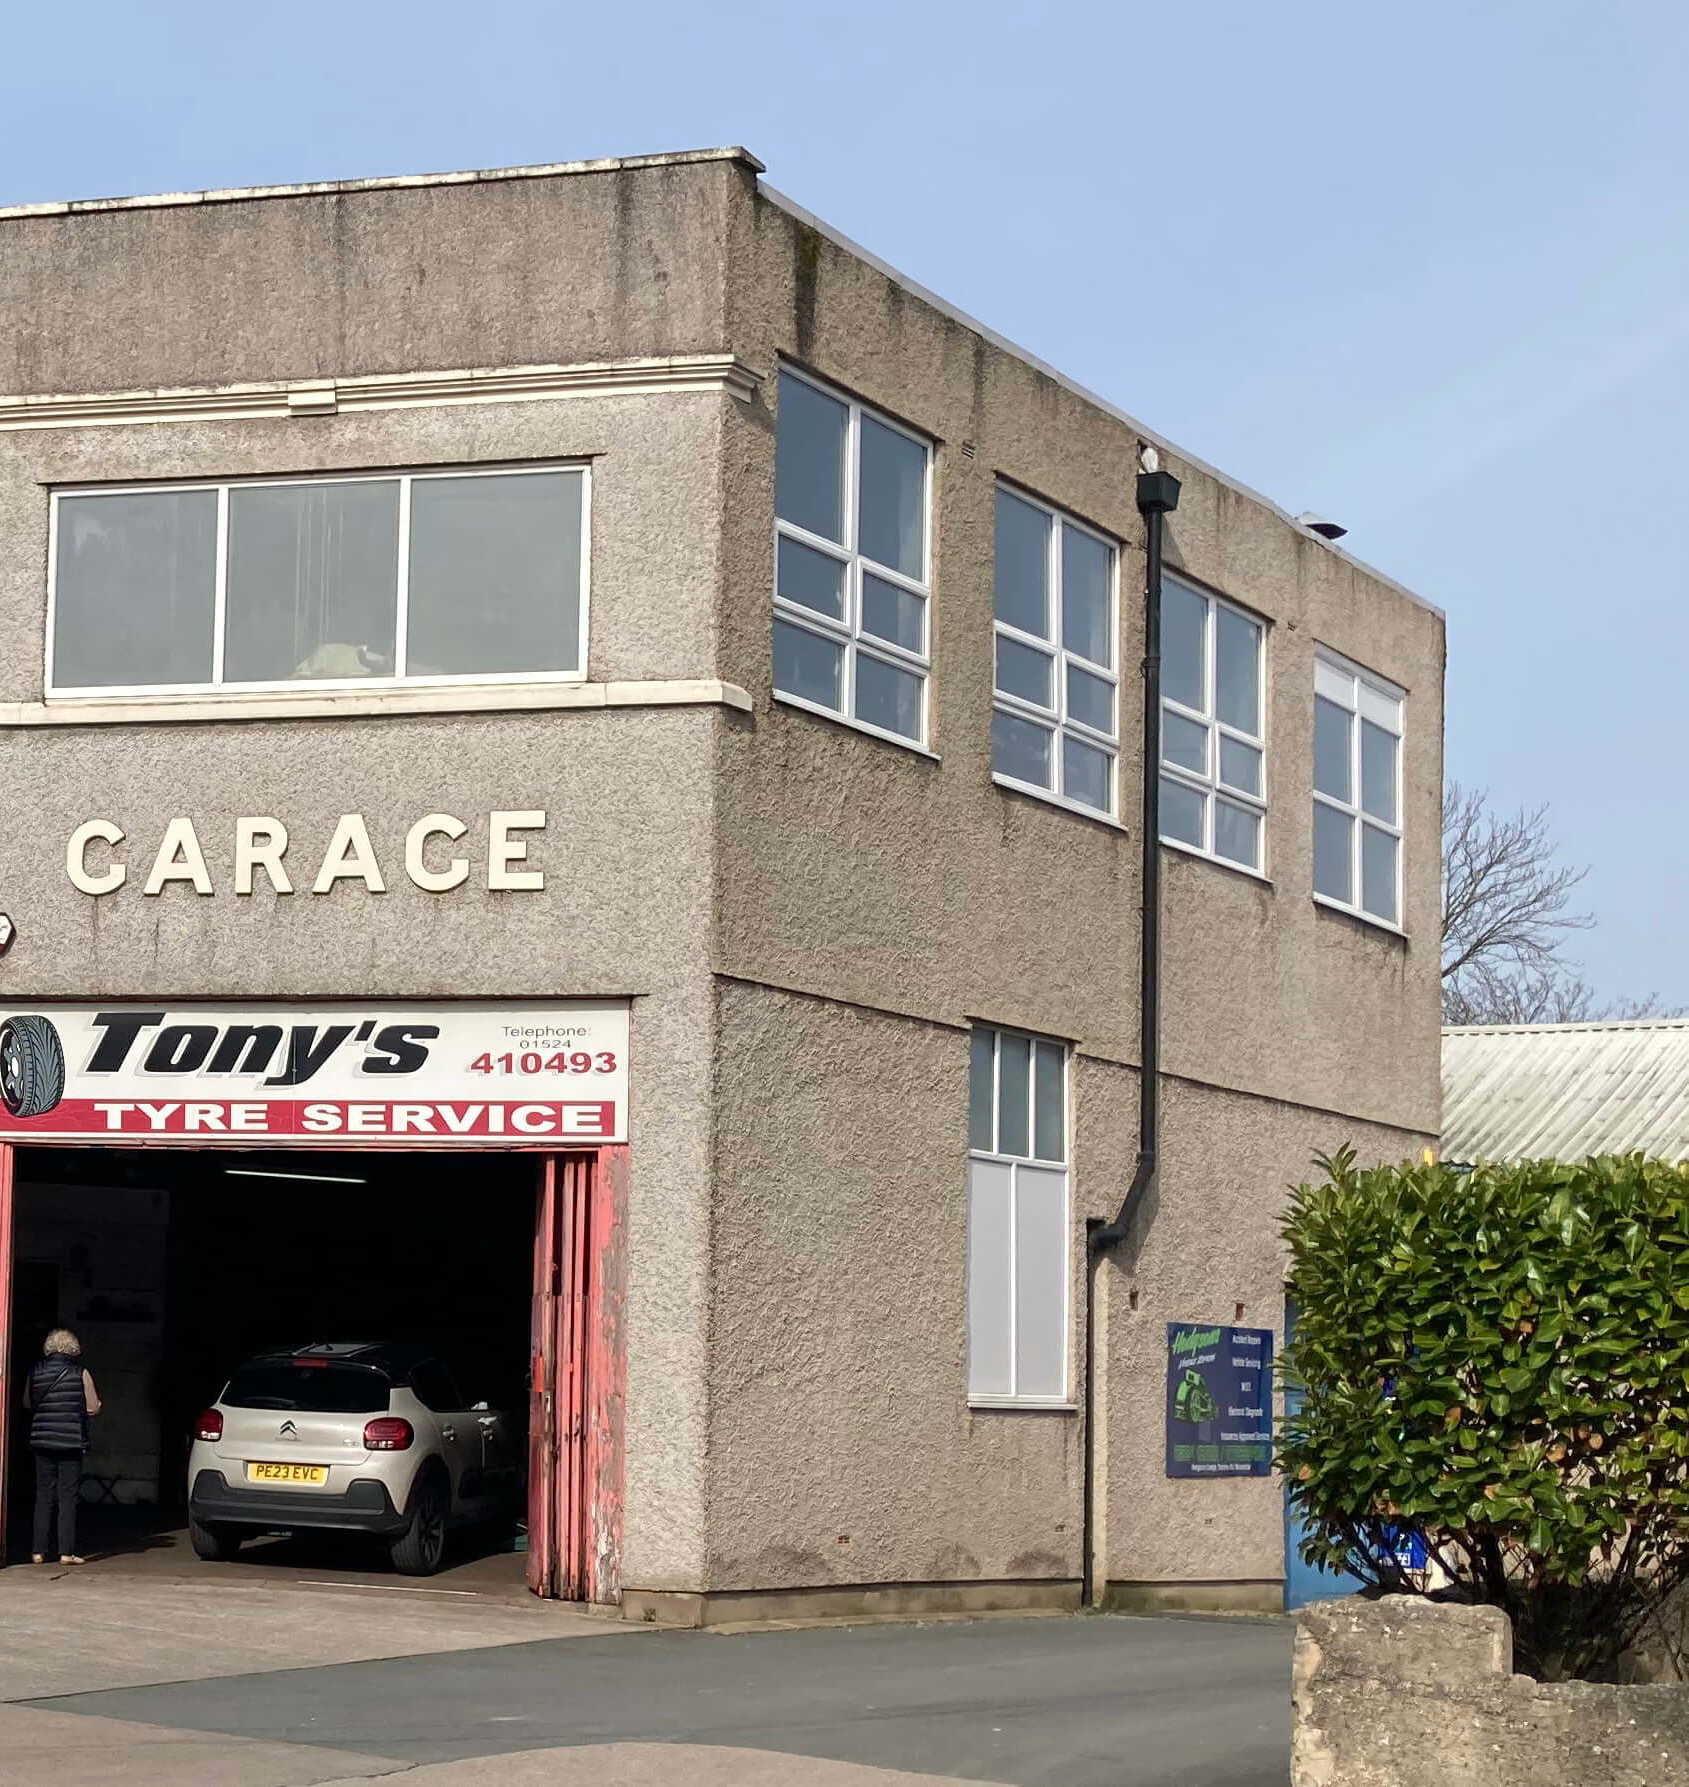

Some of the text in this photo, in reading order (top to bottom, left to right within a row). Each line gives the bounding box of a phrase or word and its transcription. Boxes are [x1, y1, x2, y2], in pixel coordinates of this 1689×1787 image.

[66, 810, 546, 895] GARAGE
[502, 1026, 592, 1040] Telephone:
[519, 1039, 572, 1050] 01524
[83, 1011, 440, 1087] Tony's
[470, 1052, 617, 1075] 410493
[94, 1103, 603, 1133] TYRE SERVICE
[256, 1465, 320, 1480] PE23 EVC
